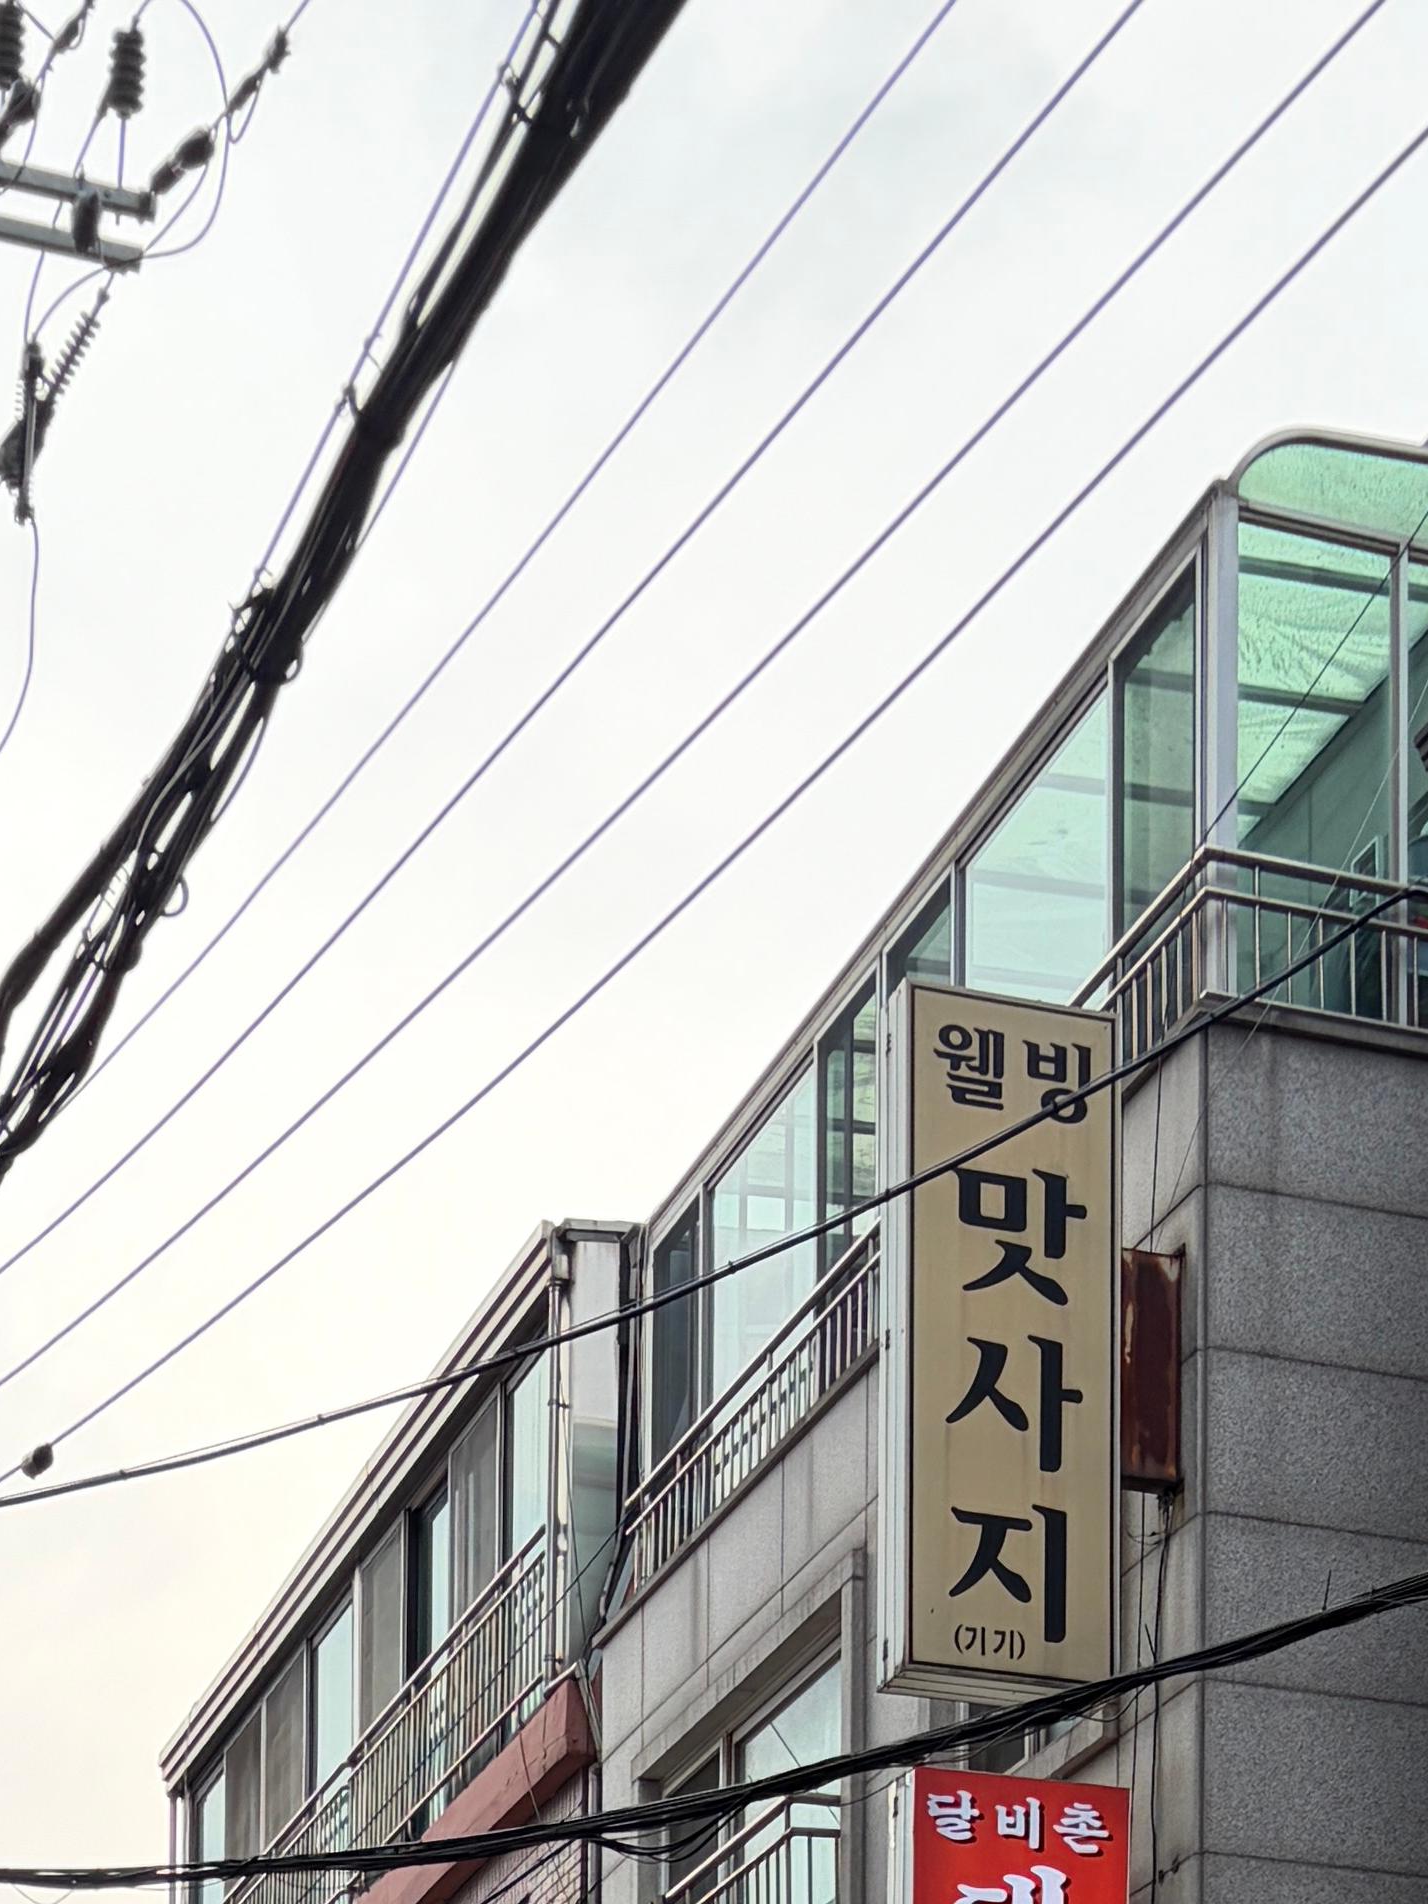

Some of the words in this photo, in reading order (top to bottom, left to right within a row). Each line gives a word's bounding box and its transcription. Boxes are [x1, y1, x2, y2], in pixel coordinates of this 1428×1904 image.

[933, 1024, 1092, 1125] 웰빙
[946, 1166, 1088, 1643] 맛사지
[953, 1623, 1027, 1660] (기기)
[926, 1790, 1112, 1855] 달비촌
